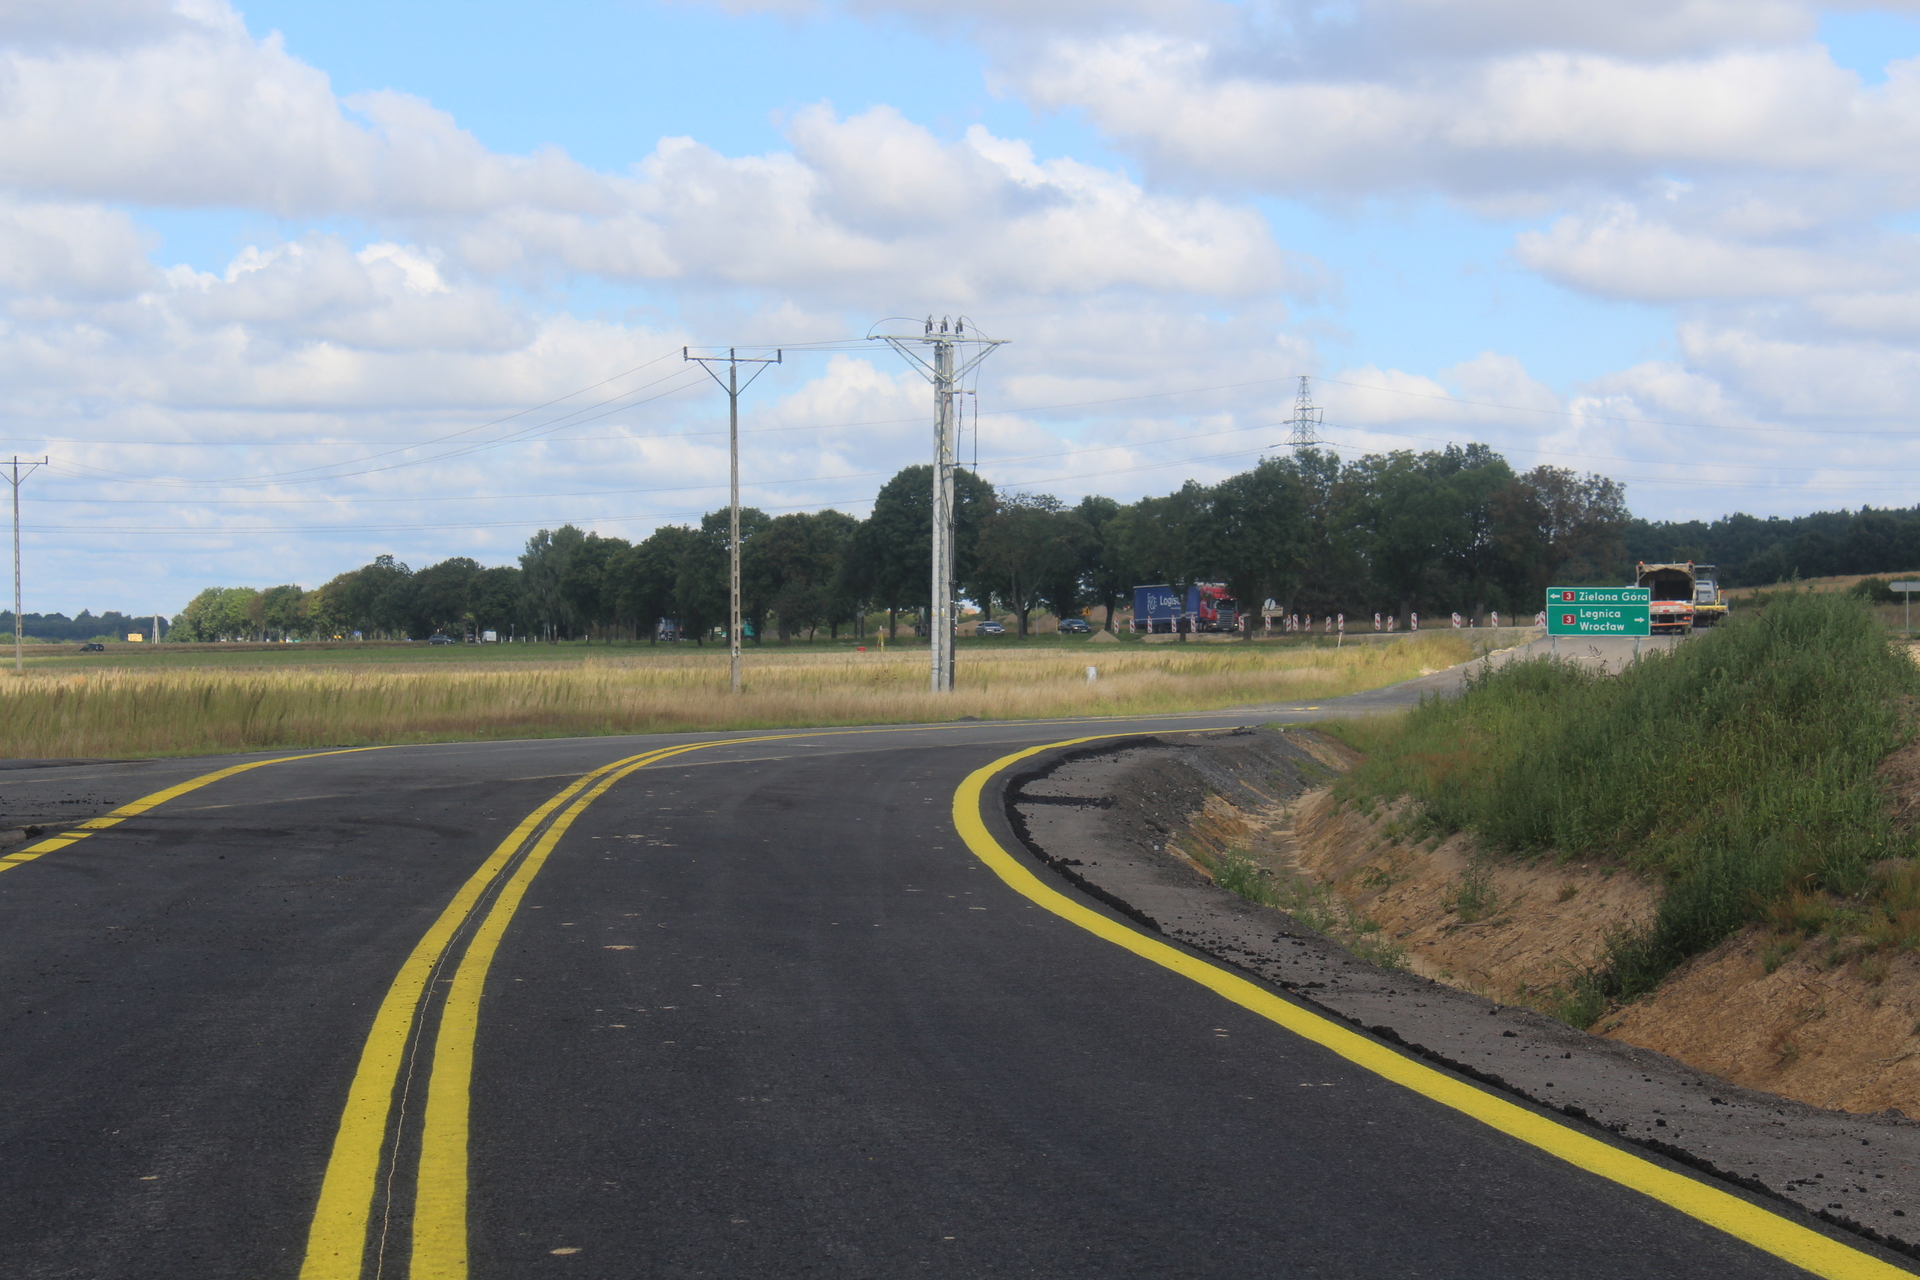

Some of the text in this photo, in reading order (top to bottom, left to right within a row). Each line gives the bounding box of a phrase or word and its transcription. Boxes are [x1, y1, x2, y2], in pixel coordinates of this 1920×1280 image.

[1579, 592, 1618, 600] Zielona
[1621, 592, 1648, 600] Góra
[1580, 609, 1621, 620] Legnica
[1580, 622, 1624, 631] Wrocław
